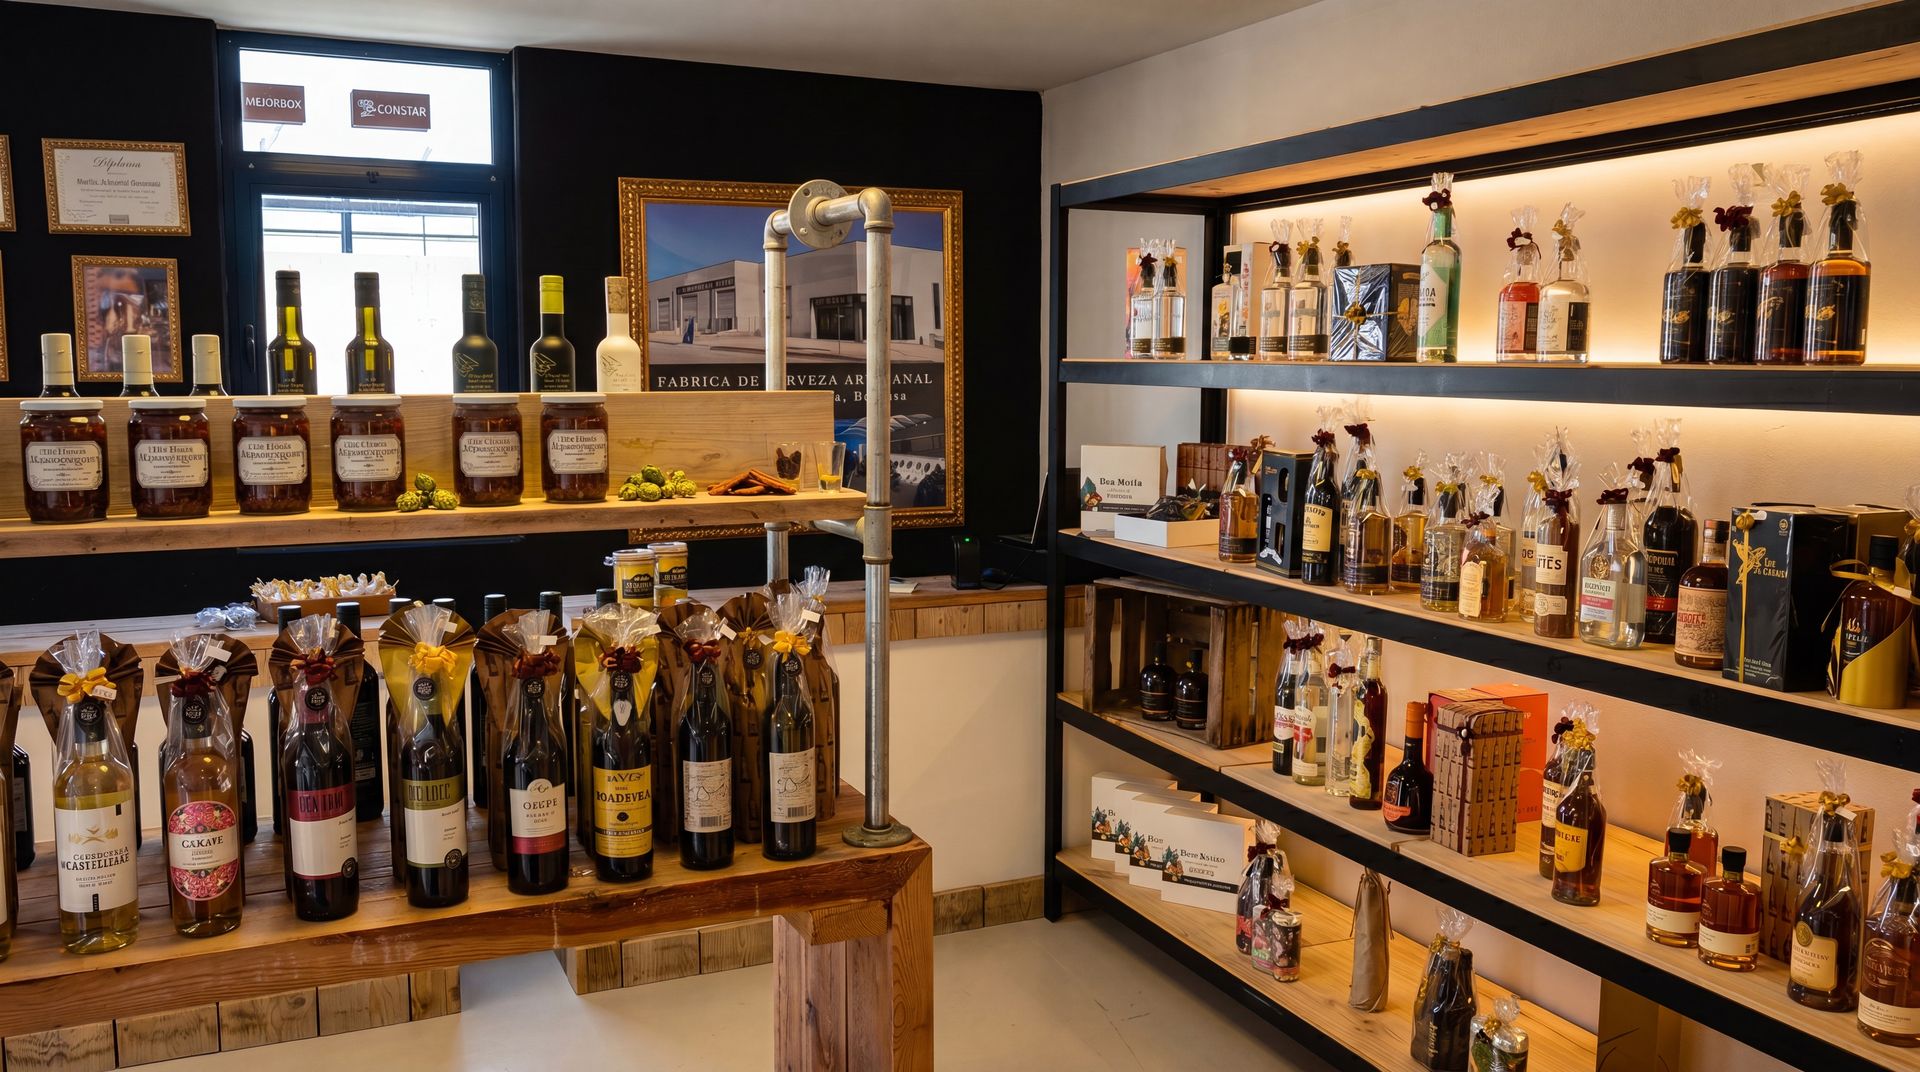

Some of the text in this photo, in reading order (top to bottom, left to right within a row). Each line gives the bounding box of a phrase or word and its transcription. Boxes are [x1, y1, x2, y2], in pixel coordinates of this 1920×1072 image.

[245, 96, 302, 109] MEJORBOX
[377, 104, 427, 117] CONSTAR
[657, 373, 933, 388] FABRICA DE RVEZA ARANAL
